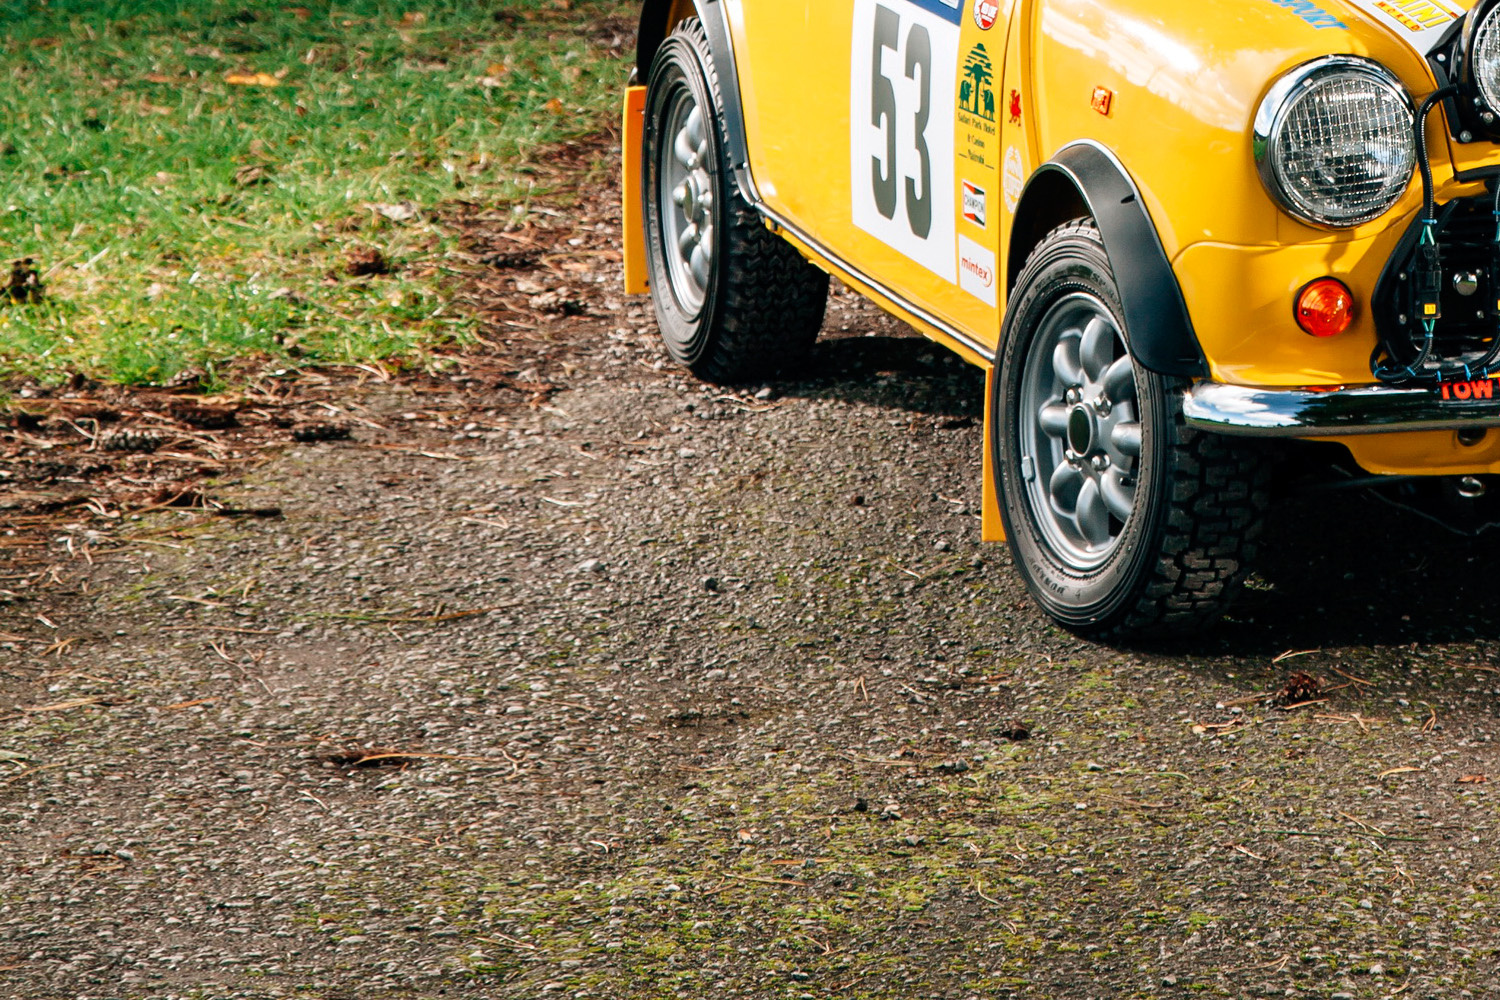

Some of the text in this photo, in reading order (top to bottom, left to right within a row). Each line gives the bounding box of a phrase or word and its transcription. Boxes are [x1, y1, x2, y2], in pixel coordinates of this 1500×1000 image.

[1377, 1, 1420, 30] WORLD
[871, 3, 932, 240] 53
[964, 193, 985, 215] CHAMPION
[961, 256, 989, 281] mintex
[1438, 380, 1493, 400] TOW
